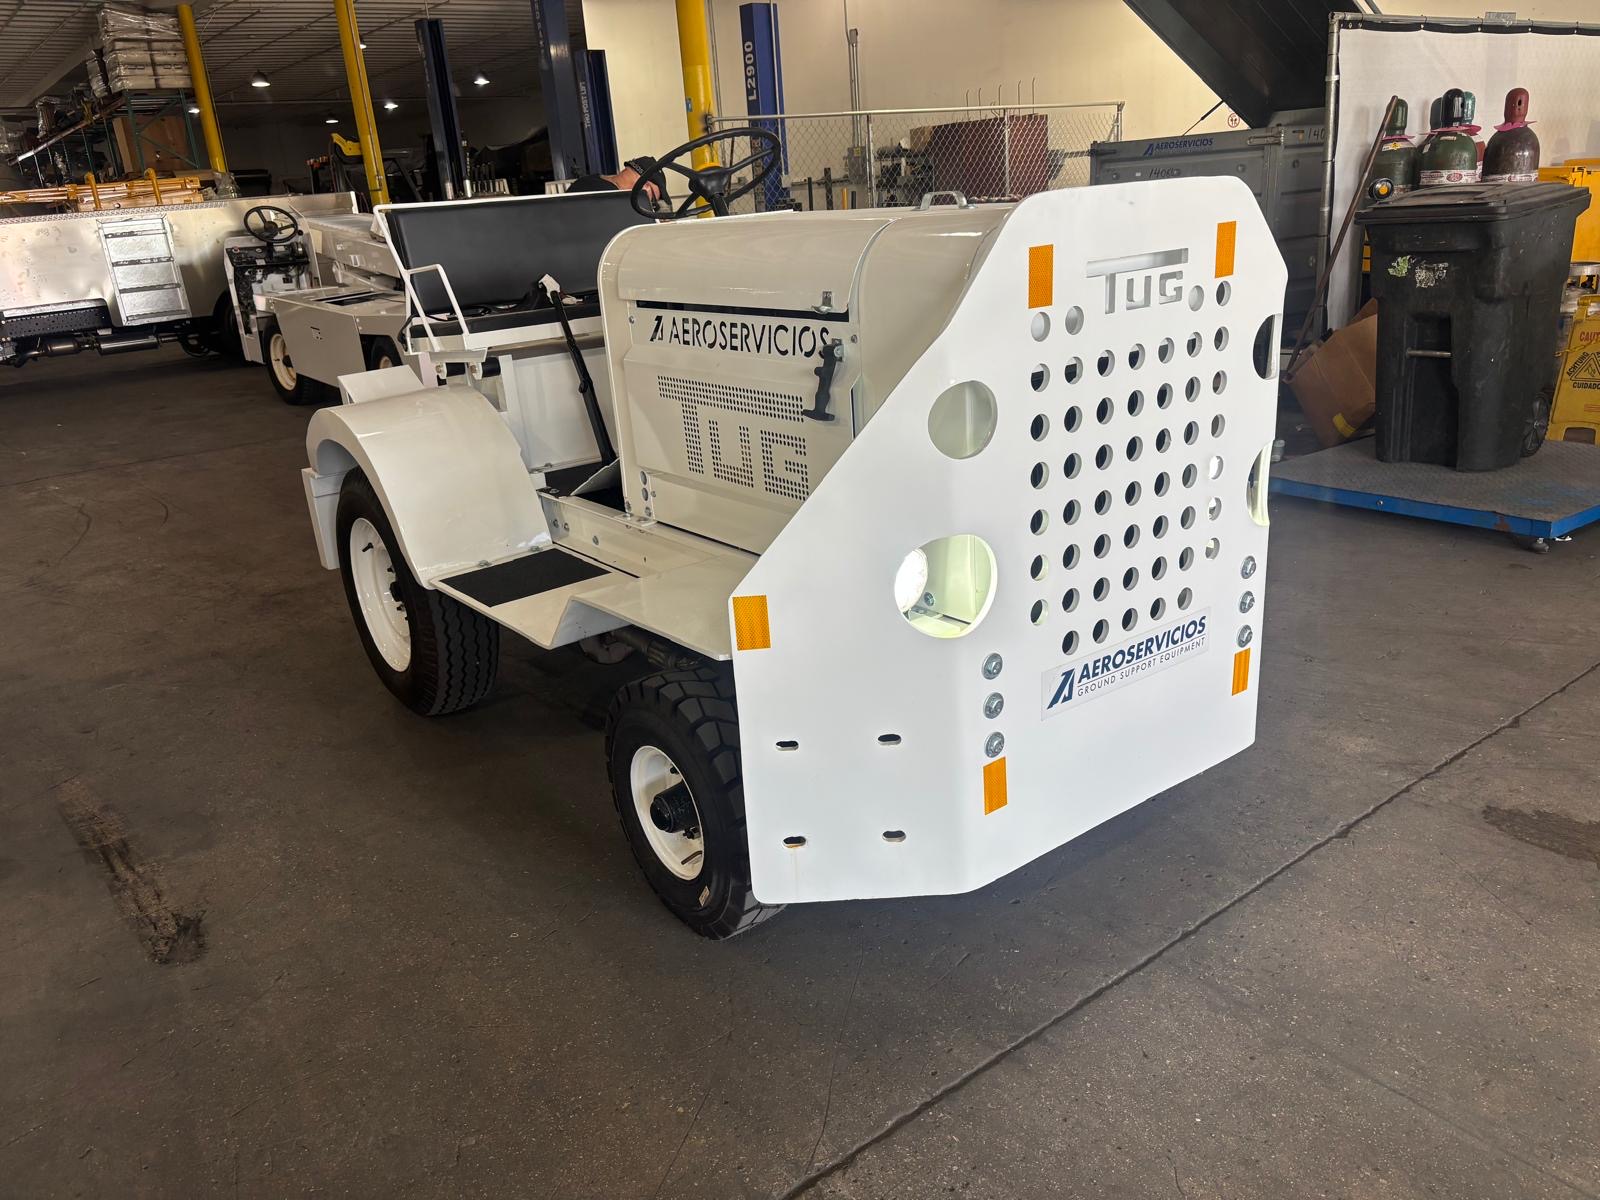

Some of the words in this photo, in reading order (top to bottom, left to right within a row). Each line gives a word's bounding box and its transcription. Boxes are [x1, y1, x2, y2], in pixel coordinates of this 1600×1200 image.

[744, 40, 758, 101] L2900
[1155, 138, 1213, 150] AEROSERVICIOS
[1086, 247, 1189, 315] TUG
[669, 316, 830, 359] AEROSERVICIOS
[1566, 351, 1590, 377] ACHTUNG
[657, 375, 810, 501] TUG
[1077, 615, 1207, 684] AEROSERVICIOS
[1077, 676, 1117, 698] GROUND
[1120, 657, 1157, 680] SUPPORT
[1159, 637, 1206, 664] EQUIPMENT
